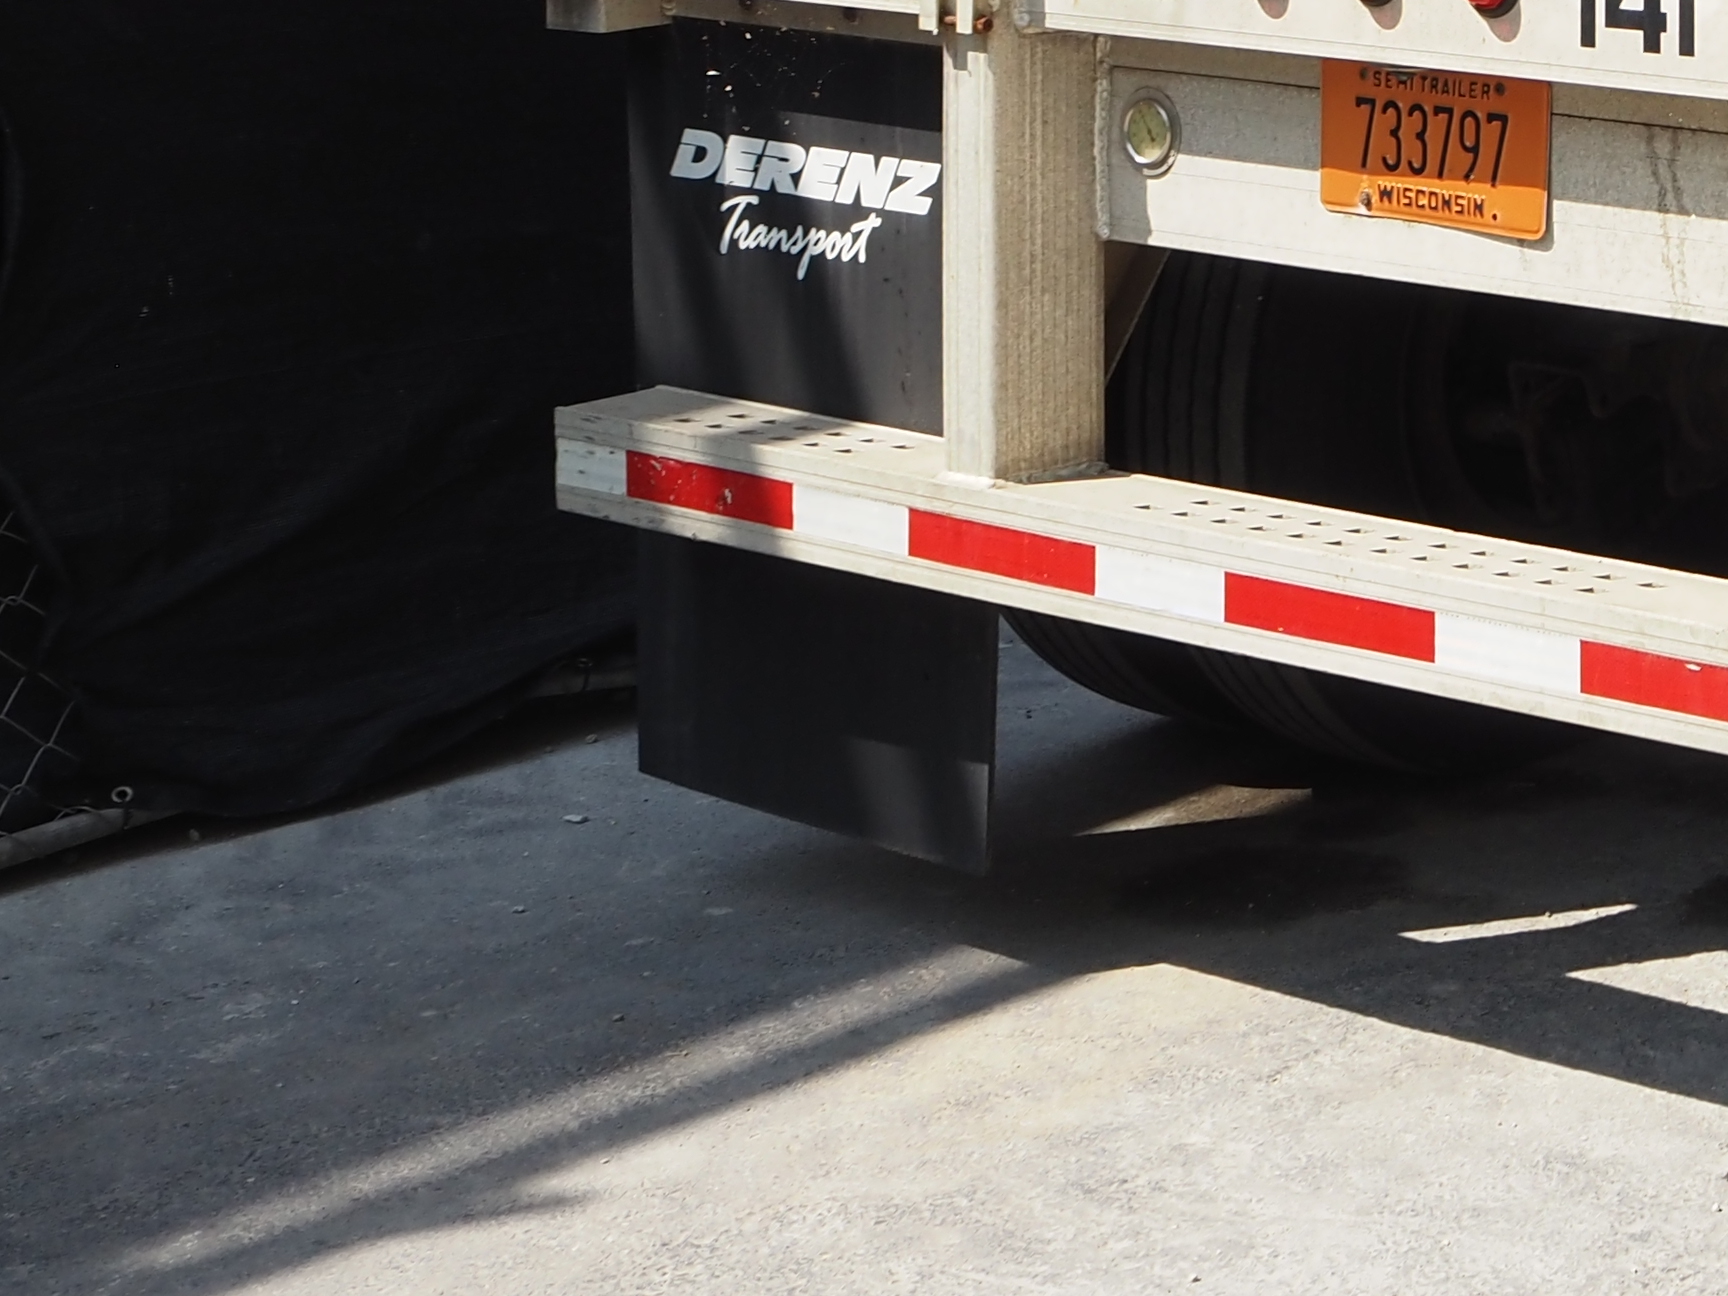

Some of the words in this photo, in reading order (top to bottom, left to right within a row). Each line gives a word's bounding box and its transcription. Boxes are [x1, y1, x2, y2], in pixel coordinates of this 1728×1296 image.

[1421, 75, 1492, 100] TRAILER
[669, 126, 942, 216] DERENZ
[1355, 95, 1509, 189] 733797
[720, 194, 882, 281] Transport
[1376, 180, 1487, 219] WISCONSIN
